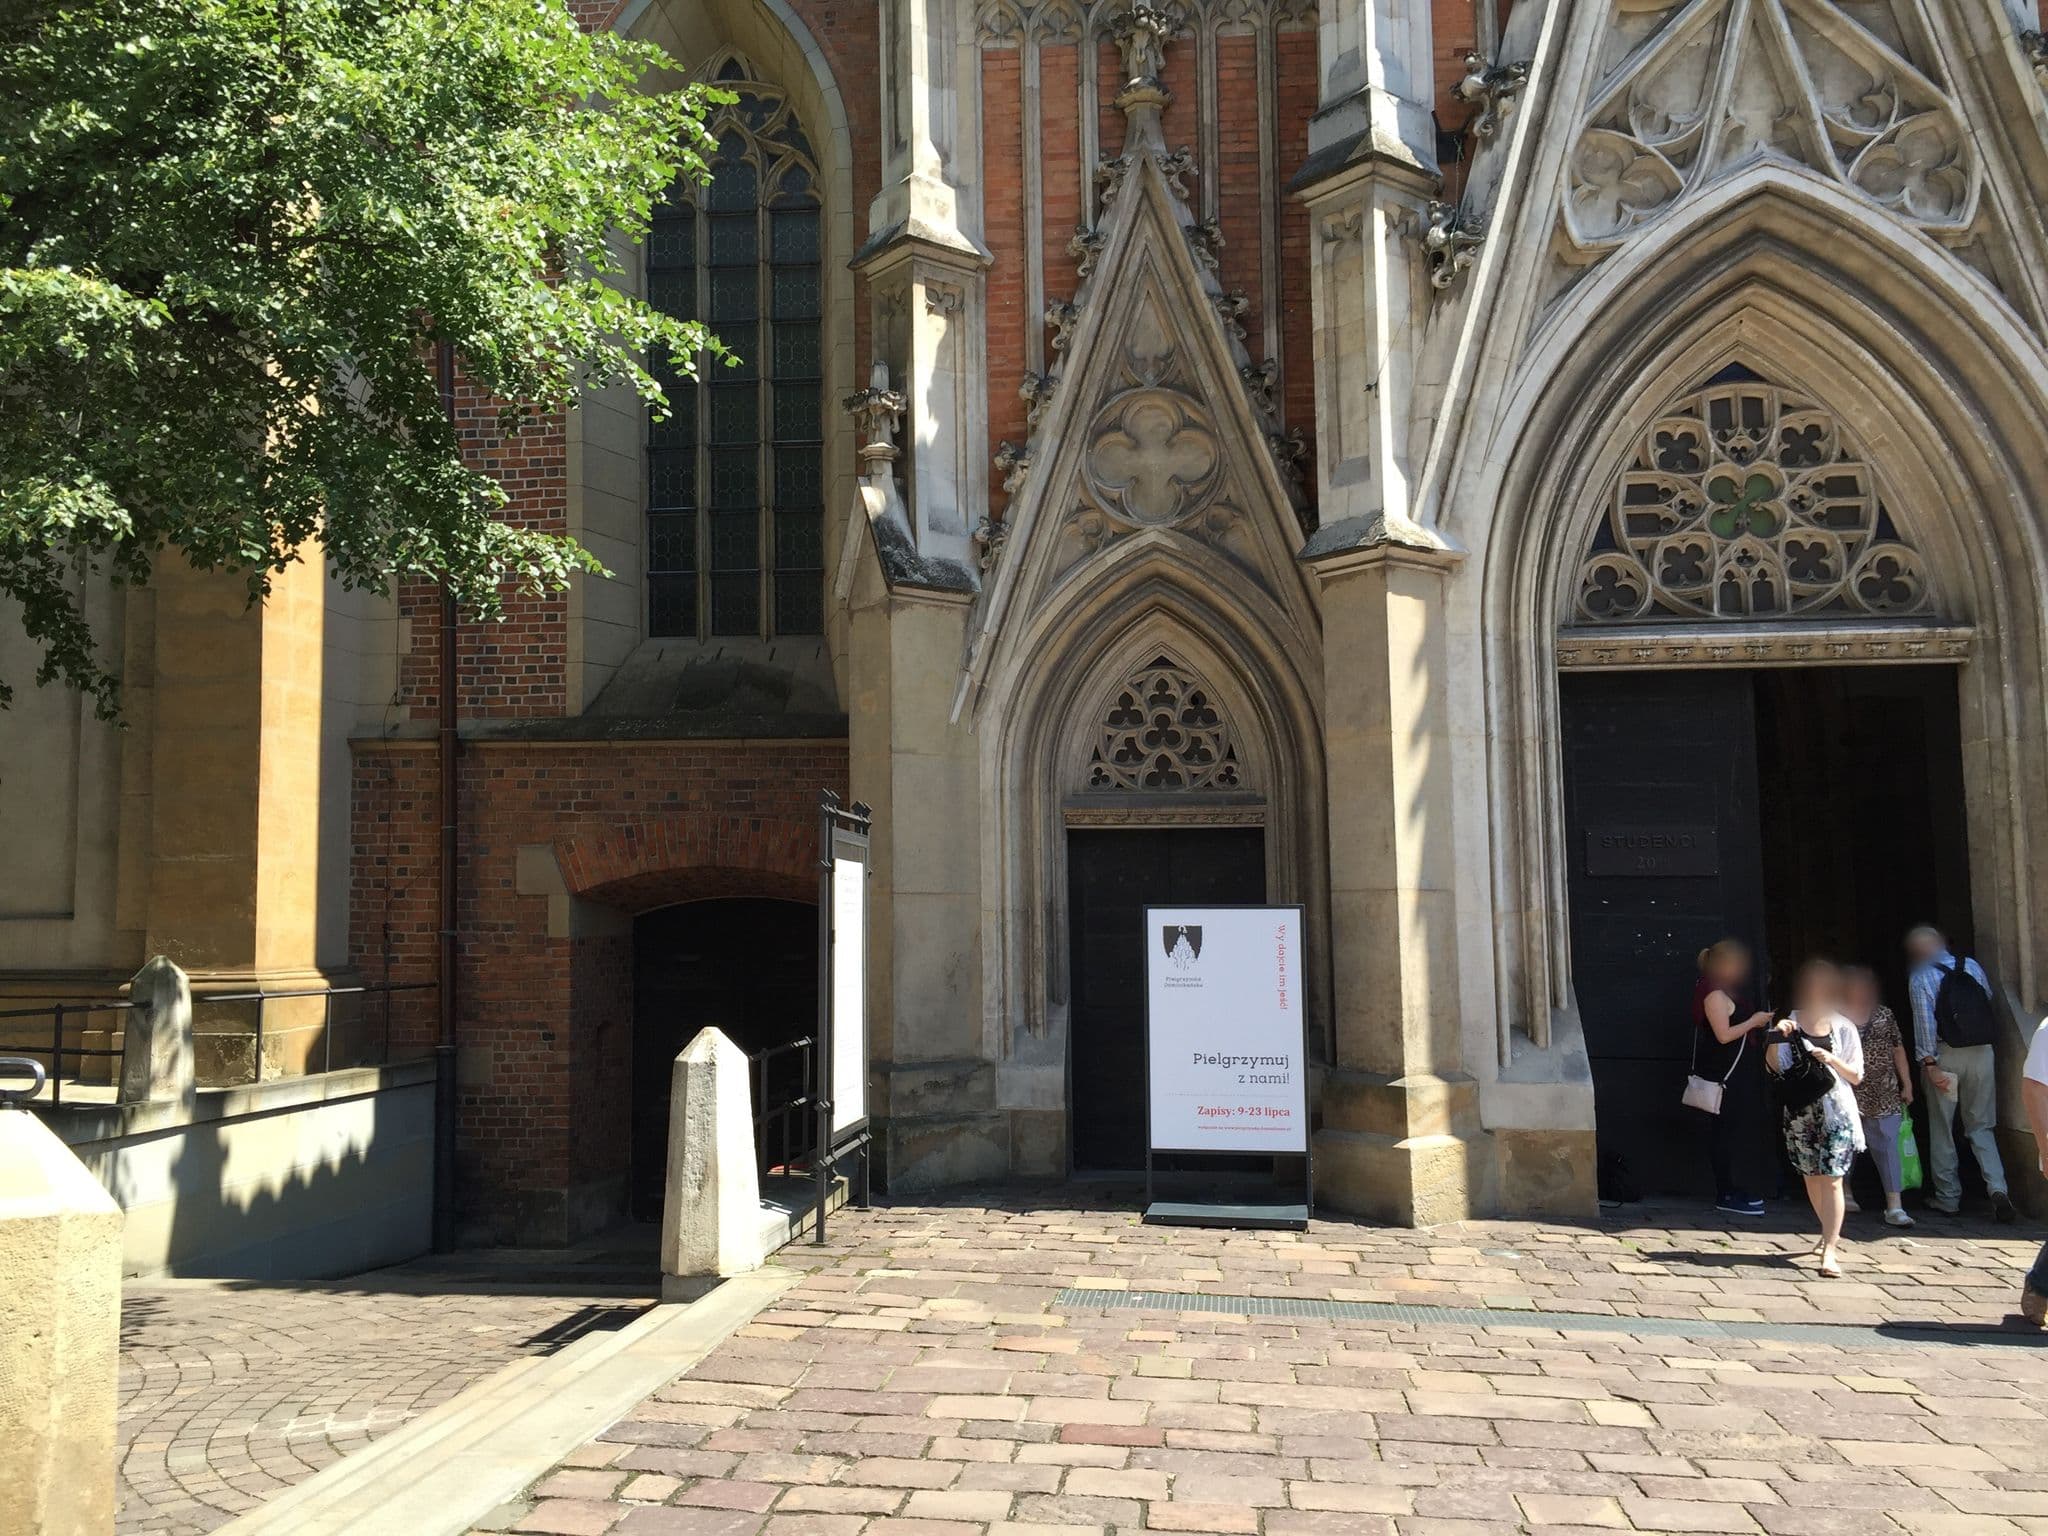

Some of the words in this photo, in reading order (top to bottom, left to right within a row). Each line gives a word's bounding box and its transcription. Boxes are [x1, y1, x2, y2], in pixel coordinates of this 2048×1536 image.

[1276, 924, 1286, 941] Wy
[1277, 943, 1287, 973] dajcie
[1278, 975, 1288, 987] im
[1192, 1052, 1289, 1069] Pielgrzymuj
[1238, 1074, 1246, 1084] z
[1249, 1073, 1290, 1084] nami!
[1197, 1106, 1236, 1118] Zapisy:
[1237, 1106, 1262, 1117] 9-23
[1264, 1106, 1291, 1118] lipca
